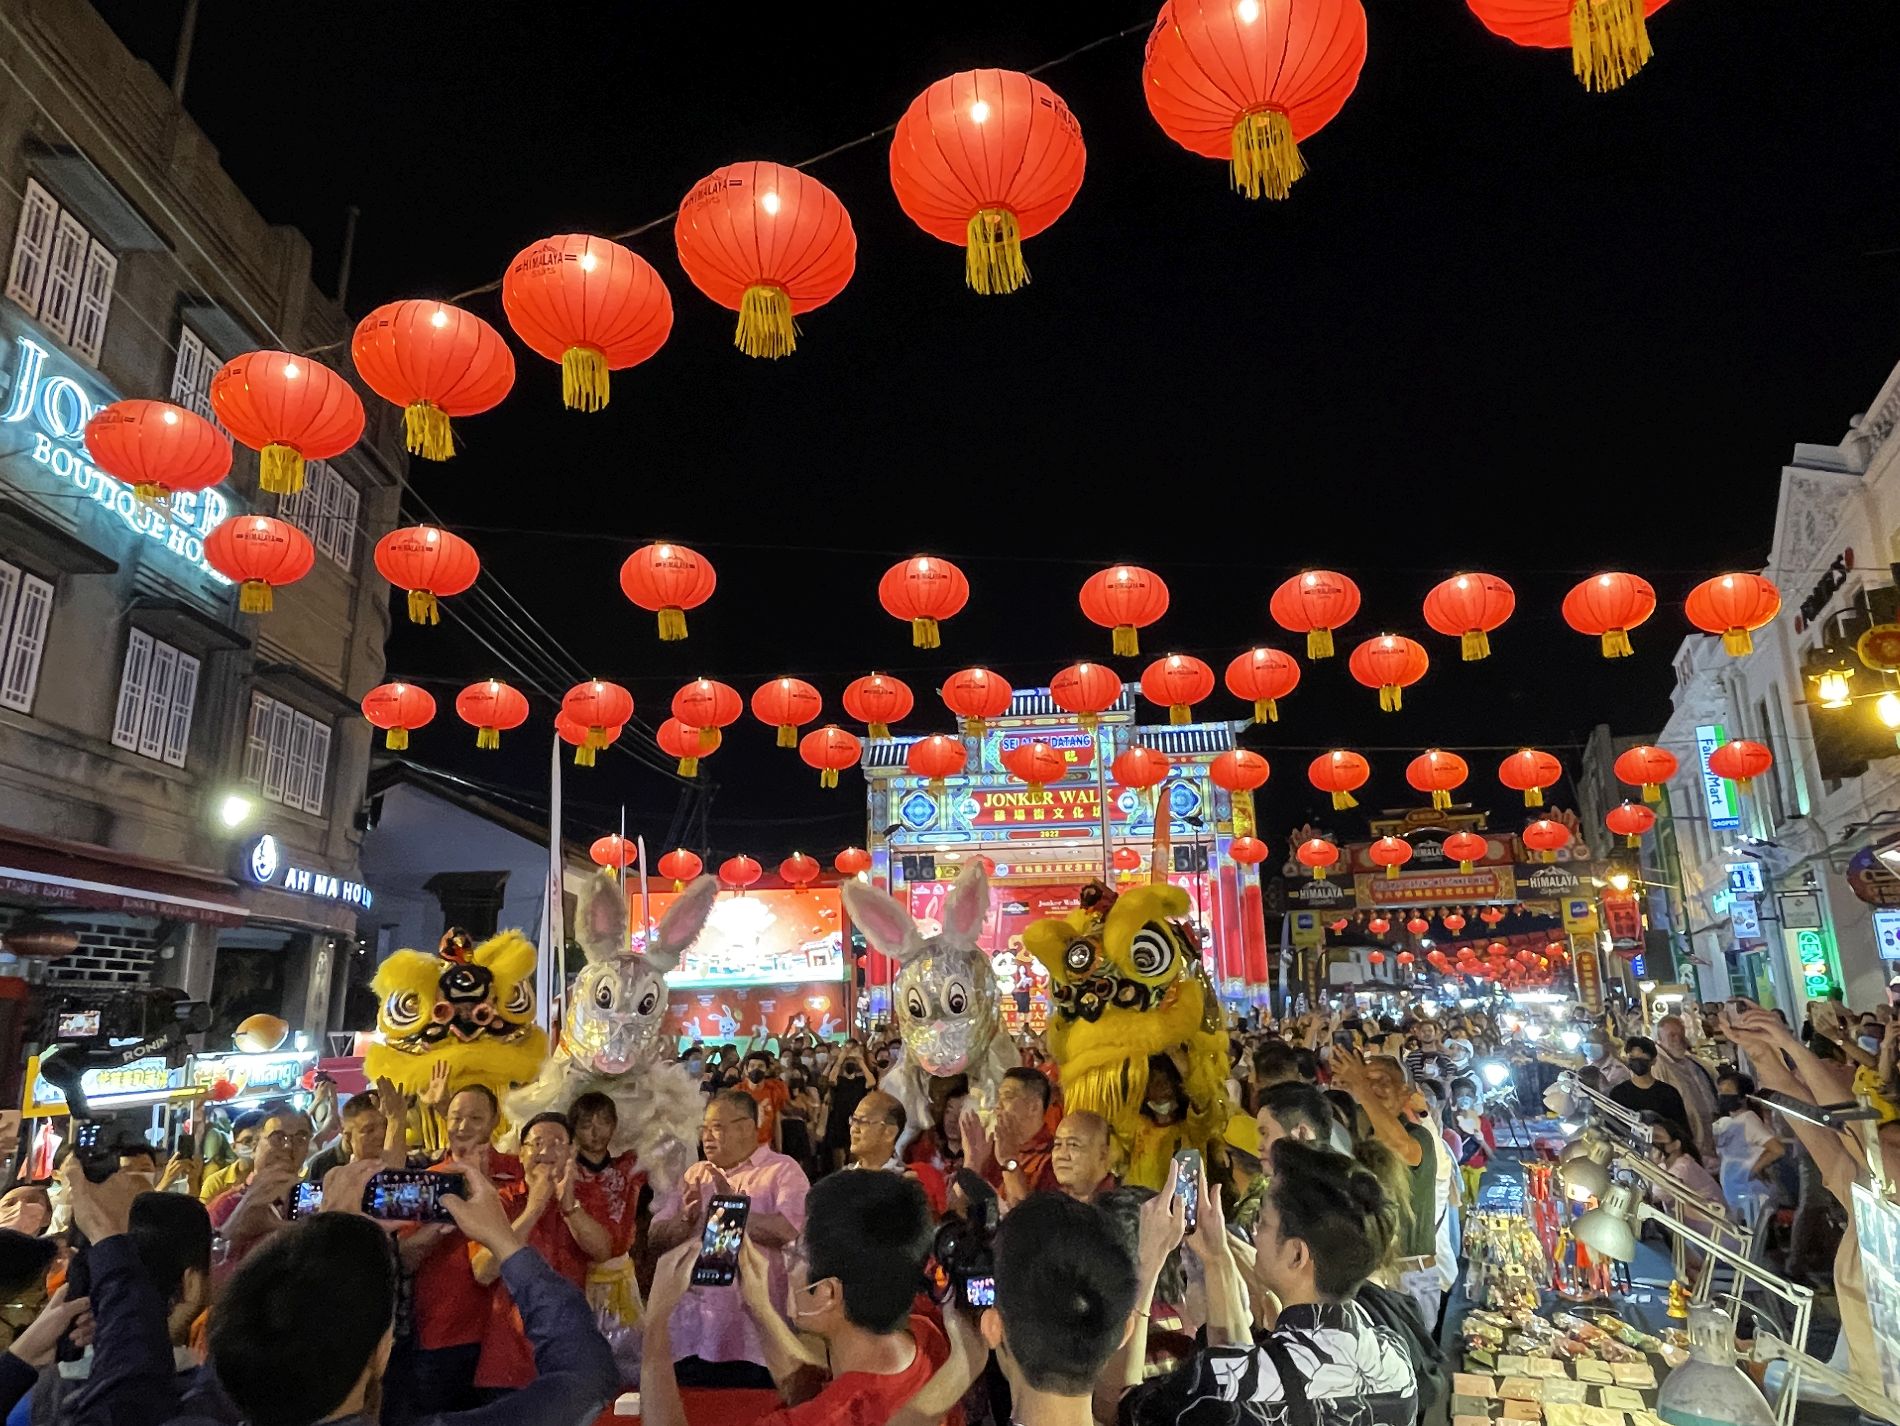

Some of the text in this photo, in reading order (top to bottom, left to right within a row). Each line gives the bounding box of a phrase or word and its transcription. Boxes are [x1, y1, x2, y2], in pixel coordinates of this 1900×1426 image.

[523, 252, 564, 272] HIMALAYA
[0, 334, 229, 539] JOER
[31, 431, 167, 542] BOUTIQUE
[1051, 735, 1091, 747] DATANG
[1701, 738, 1722, 805] FayMart
[984, 788, 1114, 807] JONKER WALK
[285, 867, 310, 892] AH
[313, 874, 338, 898] MA
[1300, 888, 1343, 899] HIMALAYA
[1530, 876, 1579, 888] HIMALAYA
[122, 1034, 168, 1062] RONIN
